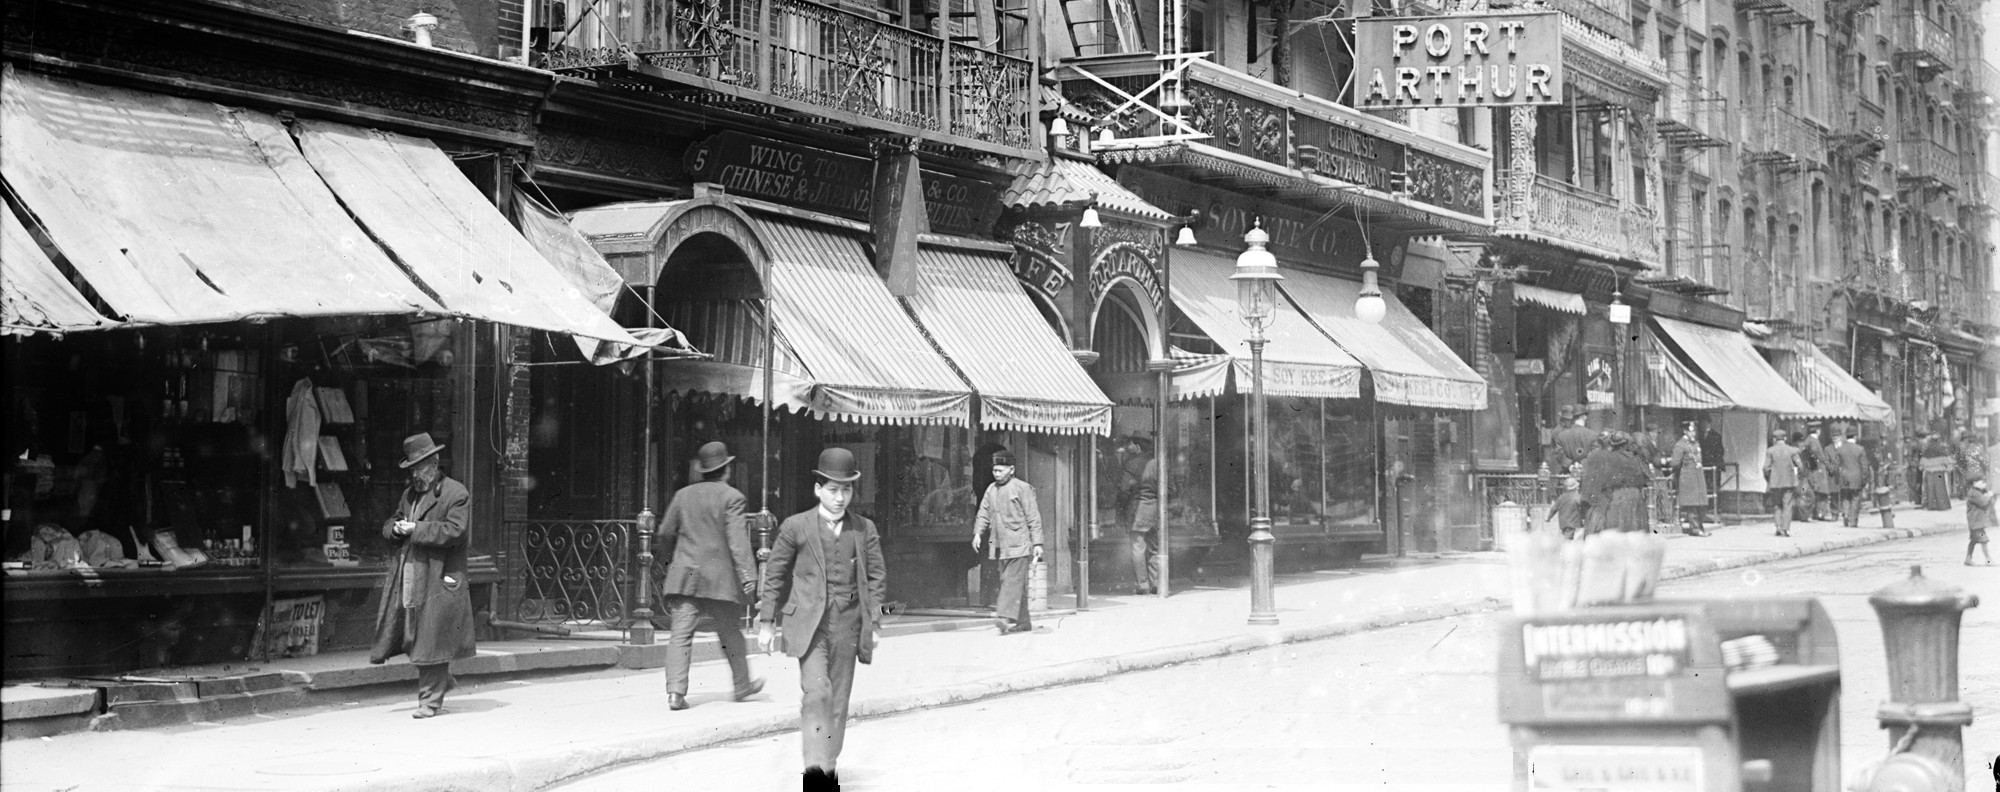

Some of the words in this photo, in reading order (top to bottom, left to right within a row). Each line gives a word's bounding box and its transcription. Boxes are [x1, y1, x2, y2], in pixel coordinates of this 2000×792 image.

[1393, 21, 1524, 58] PORT
[1365, 64, 1552, 101] ARTHUR
[693, 149, 709, 171] 5
[1329, 126, 1375, 159] CHINESE
[720, 164, 795, 198] CHINESE
[793, 178, 808, 202] &
[1316, 150, 1387, 189] RESTAURANT
[947, 184, 968, 203] CO.
[1055, 211, 1072, 247] 7
[1309, 224, 1338, 255] CO.
[1089, 252, 1117, 304] PORT
[1117, 251, 1163, 316] ARTHUR
[1272, 367, 1295, 385] SOY
[1301, 368, 1326, 386] KEE
